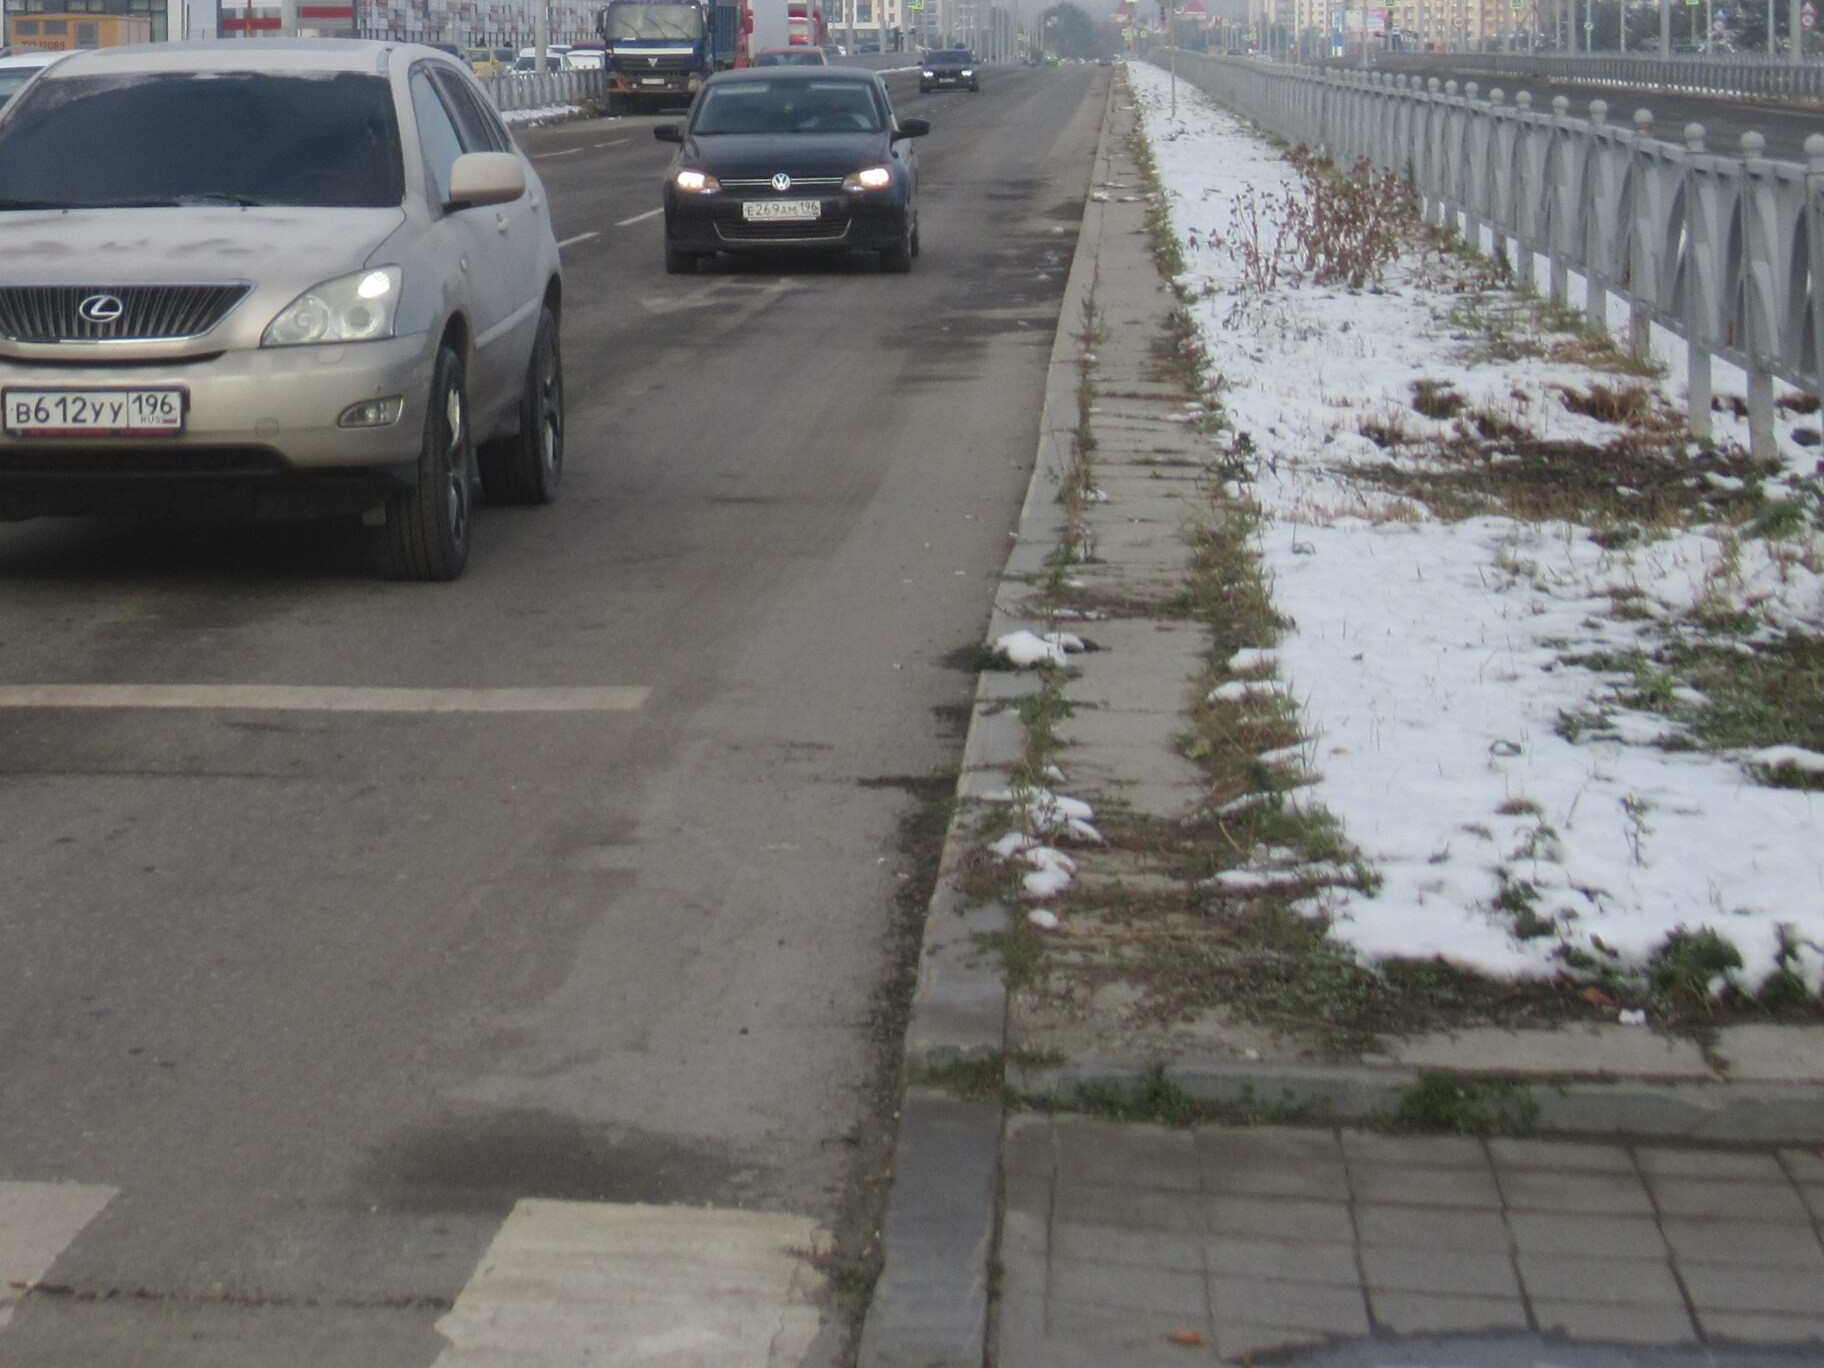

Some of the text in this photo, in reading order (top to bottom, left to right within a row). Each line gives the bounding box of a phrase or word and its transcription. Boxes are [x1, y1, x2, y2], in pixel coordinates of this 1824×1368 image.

[799, 201, 817, 212] 196
[15, 393, 174, 425] В612УУ 196
